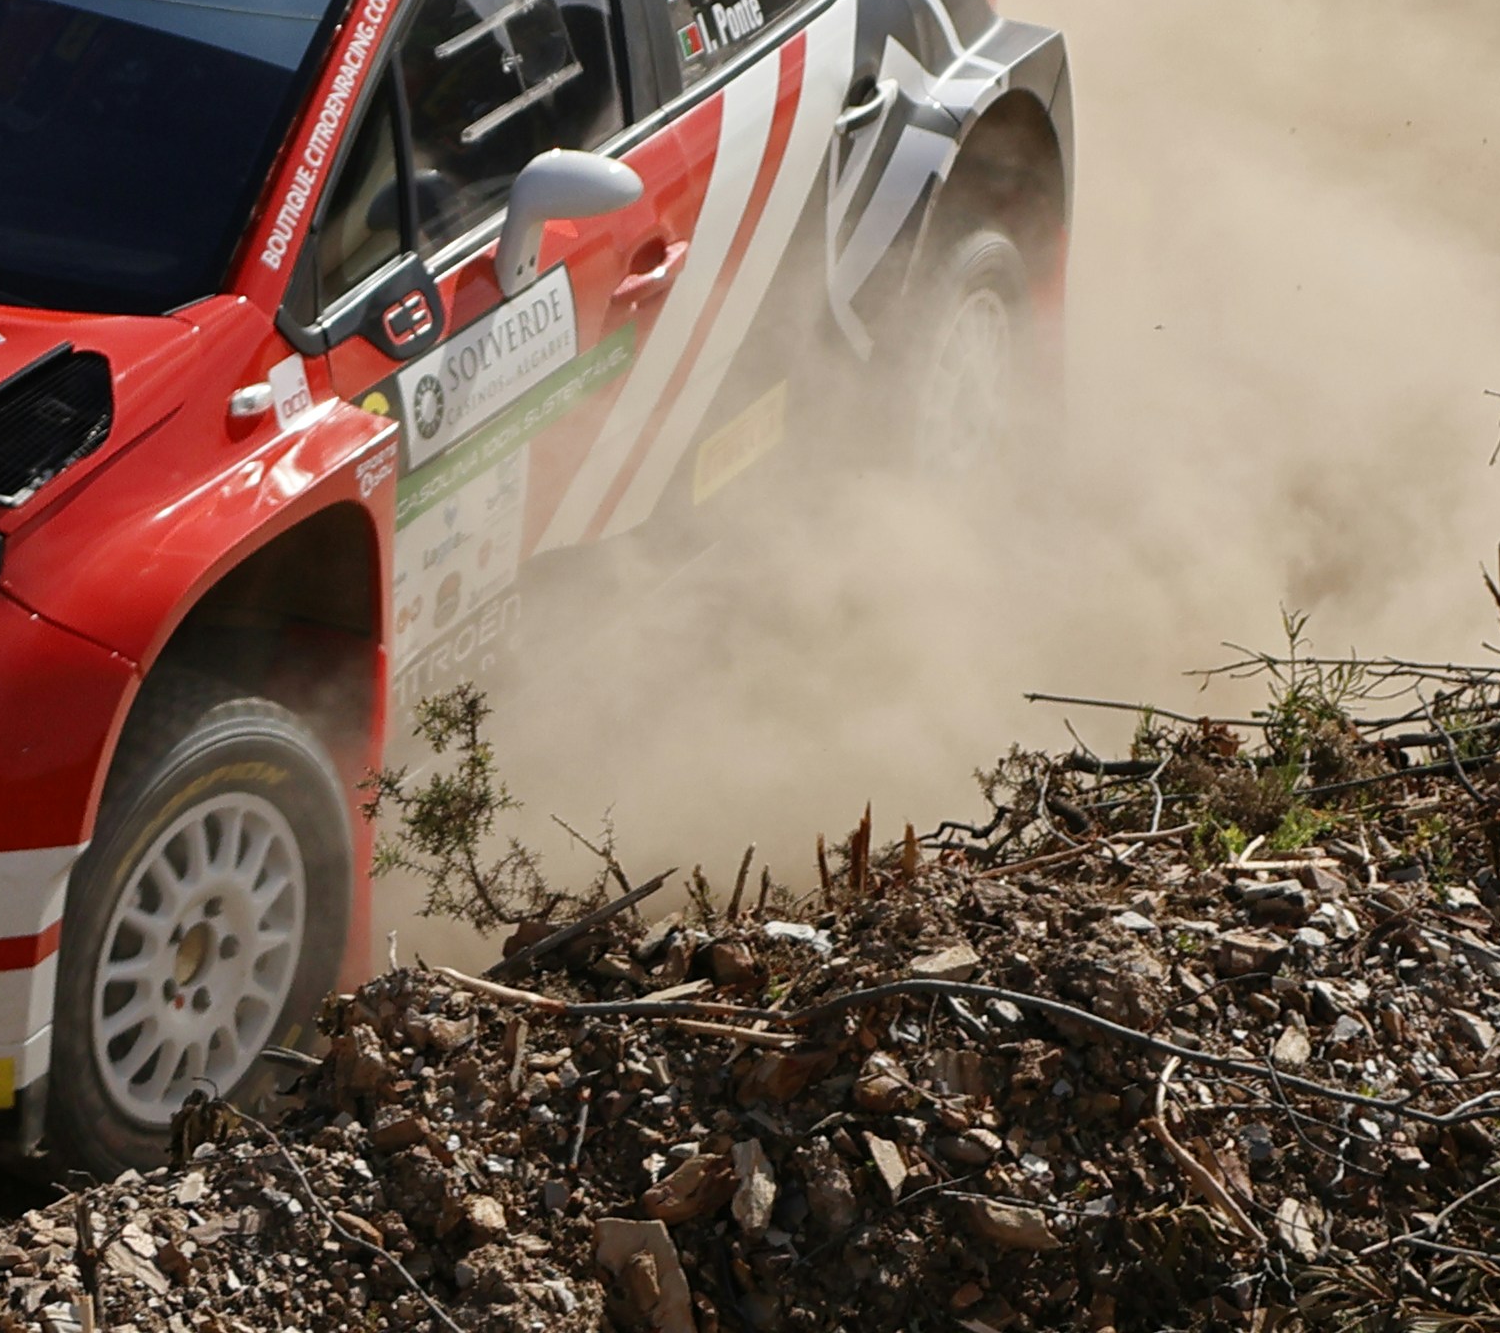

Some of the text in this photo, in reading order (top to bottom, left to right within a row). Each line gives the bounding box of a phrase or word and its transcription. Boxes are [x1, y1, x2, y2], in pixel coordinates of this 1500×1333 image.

[447, 288, 563, 392] SOLVERDE
[447, 329, 570, 426] CASINOS ALGARVE
